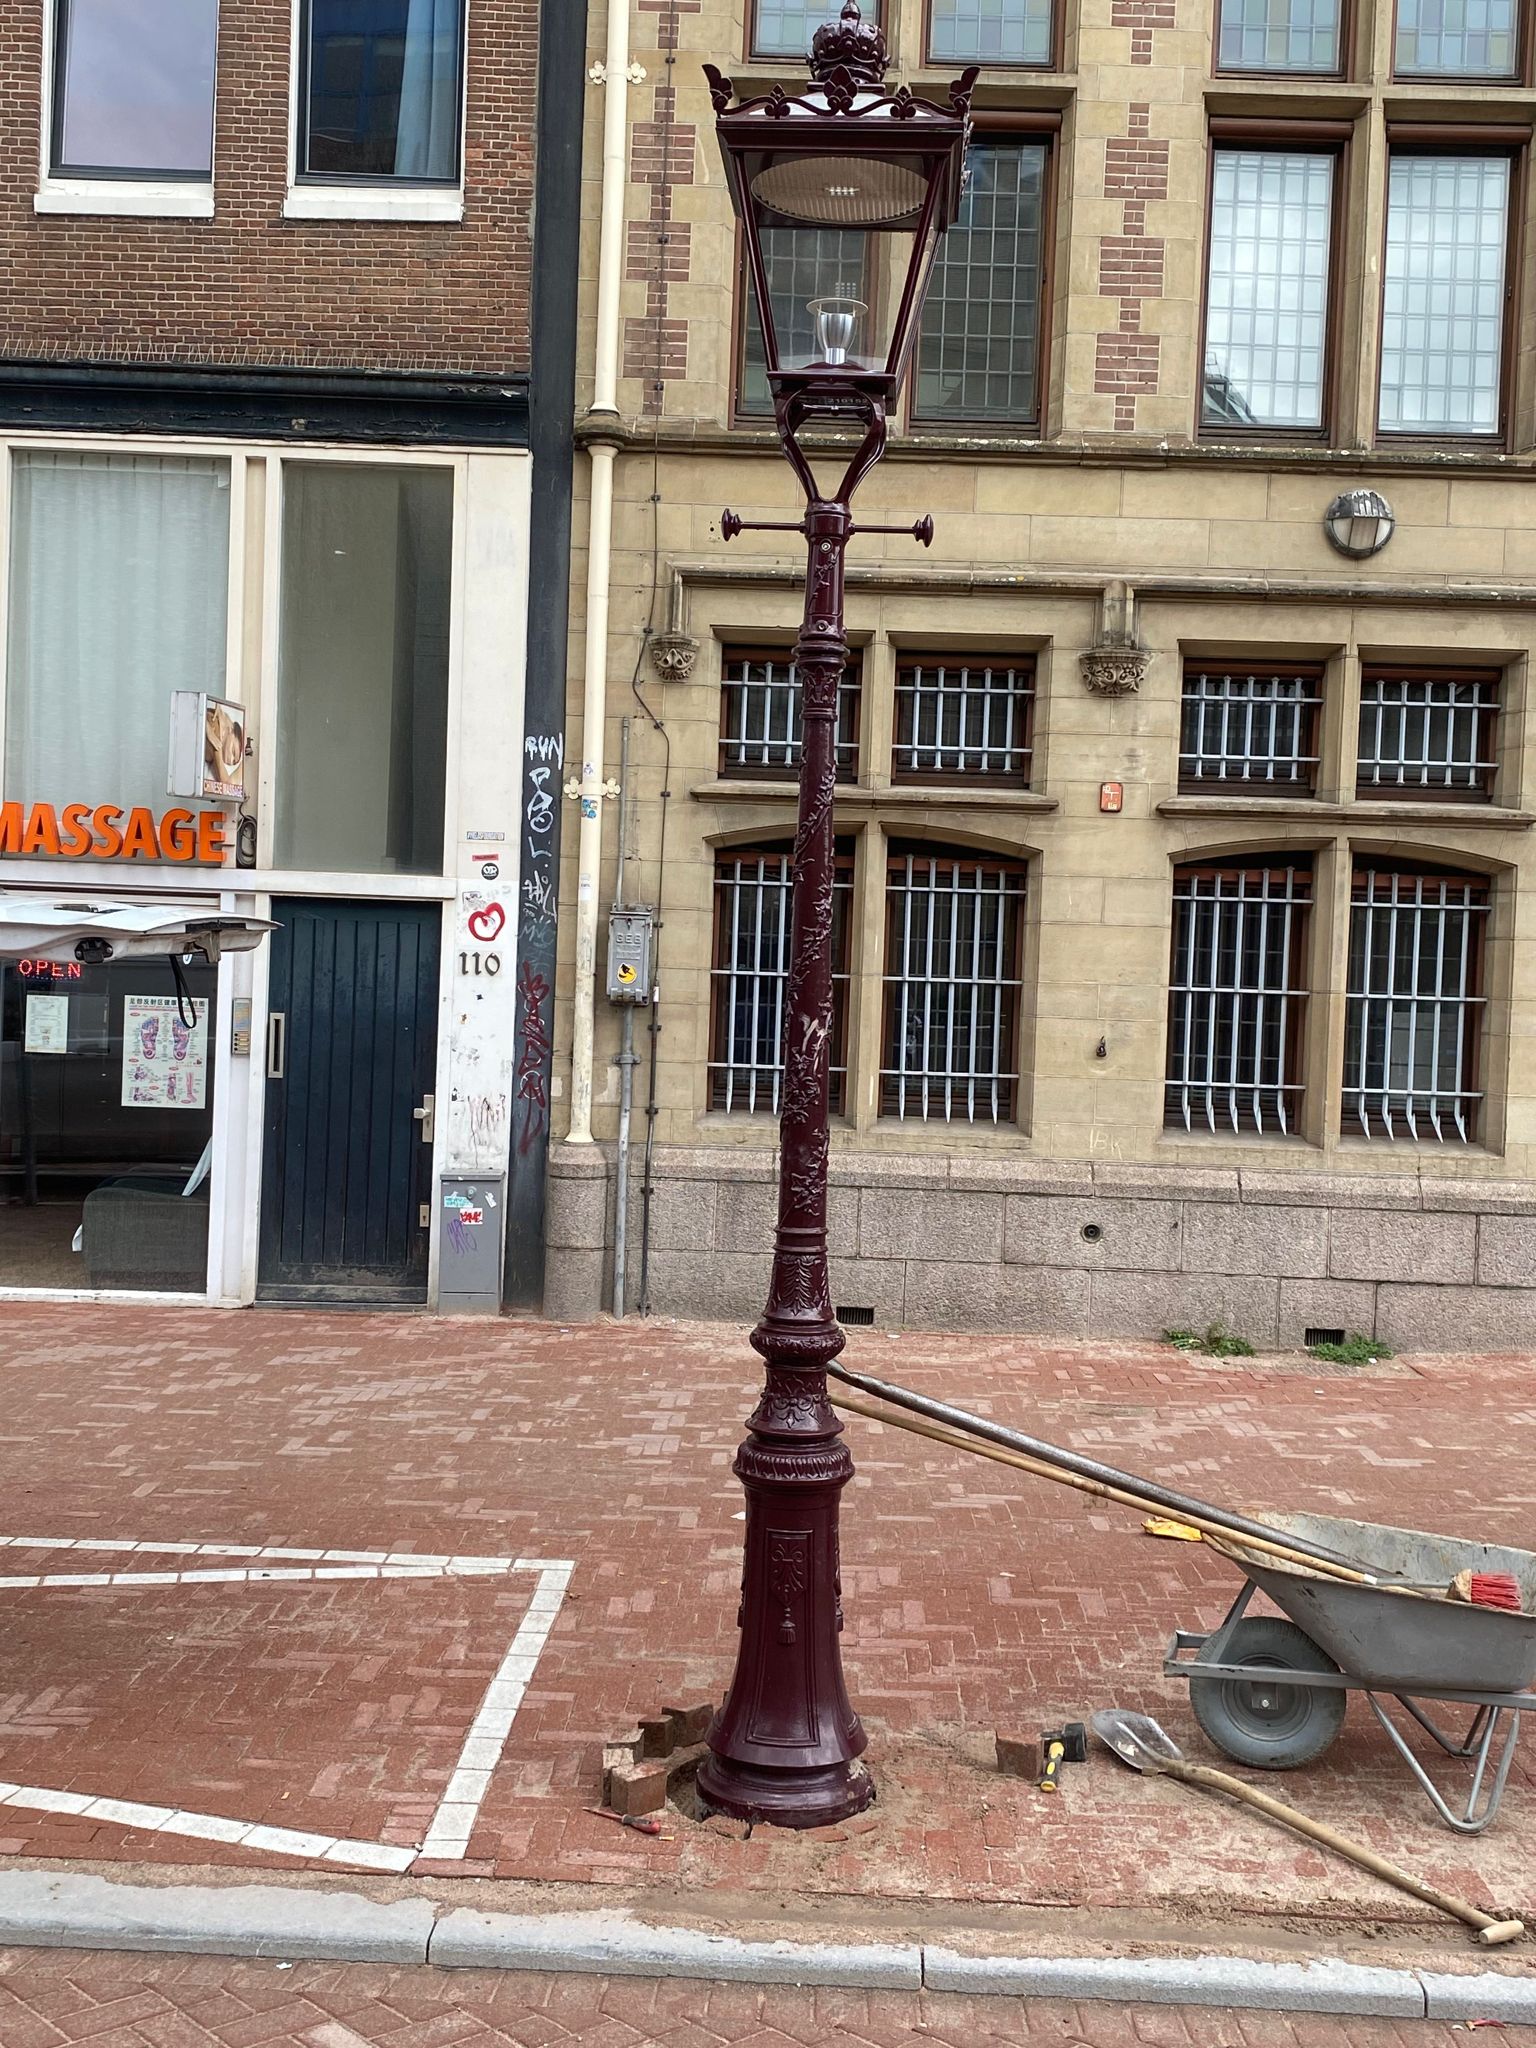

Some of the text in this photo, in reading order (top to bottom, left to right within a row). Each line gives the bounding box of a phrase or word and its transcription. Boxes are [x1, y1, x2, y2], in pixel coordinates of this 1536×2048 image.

[616, 933, 641, 944] GEB
[19, 959, 81, 977] OPEN
[459, 951, 501, 977] 110
